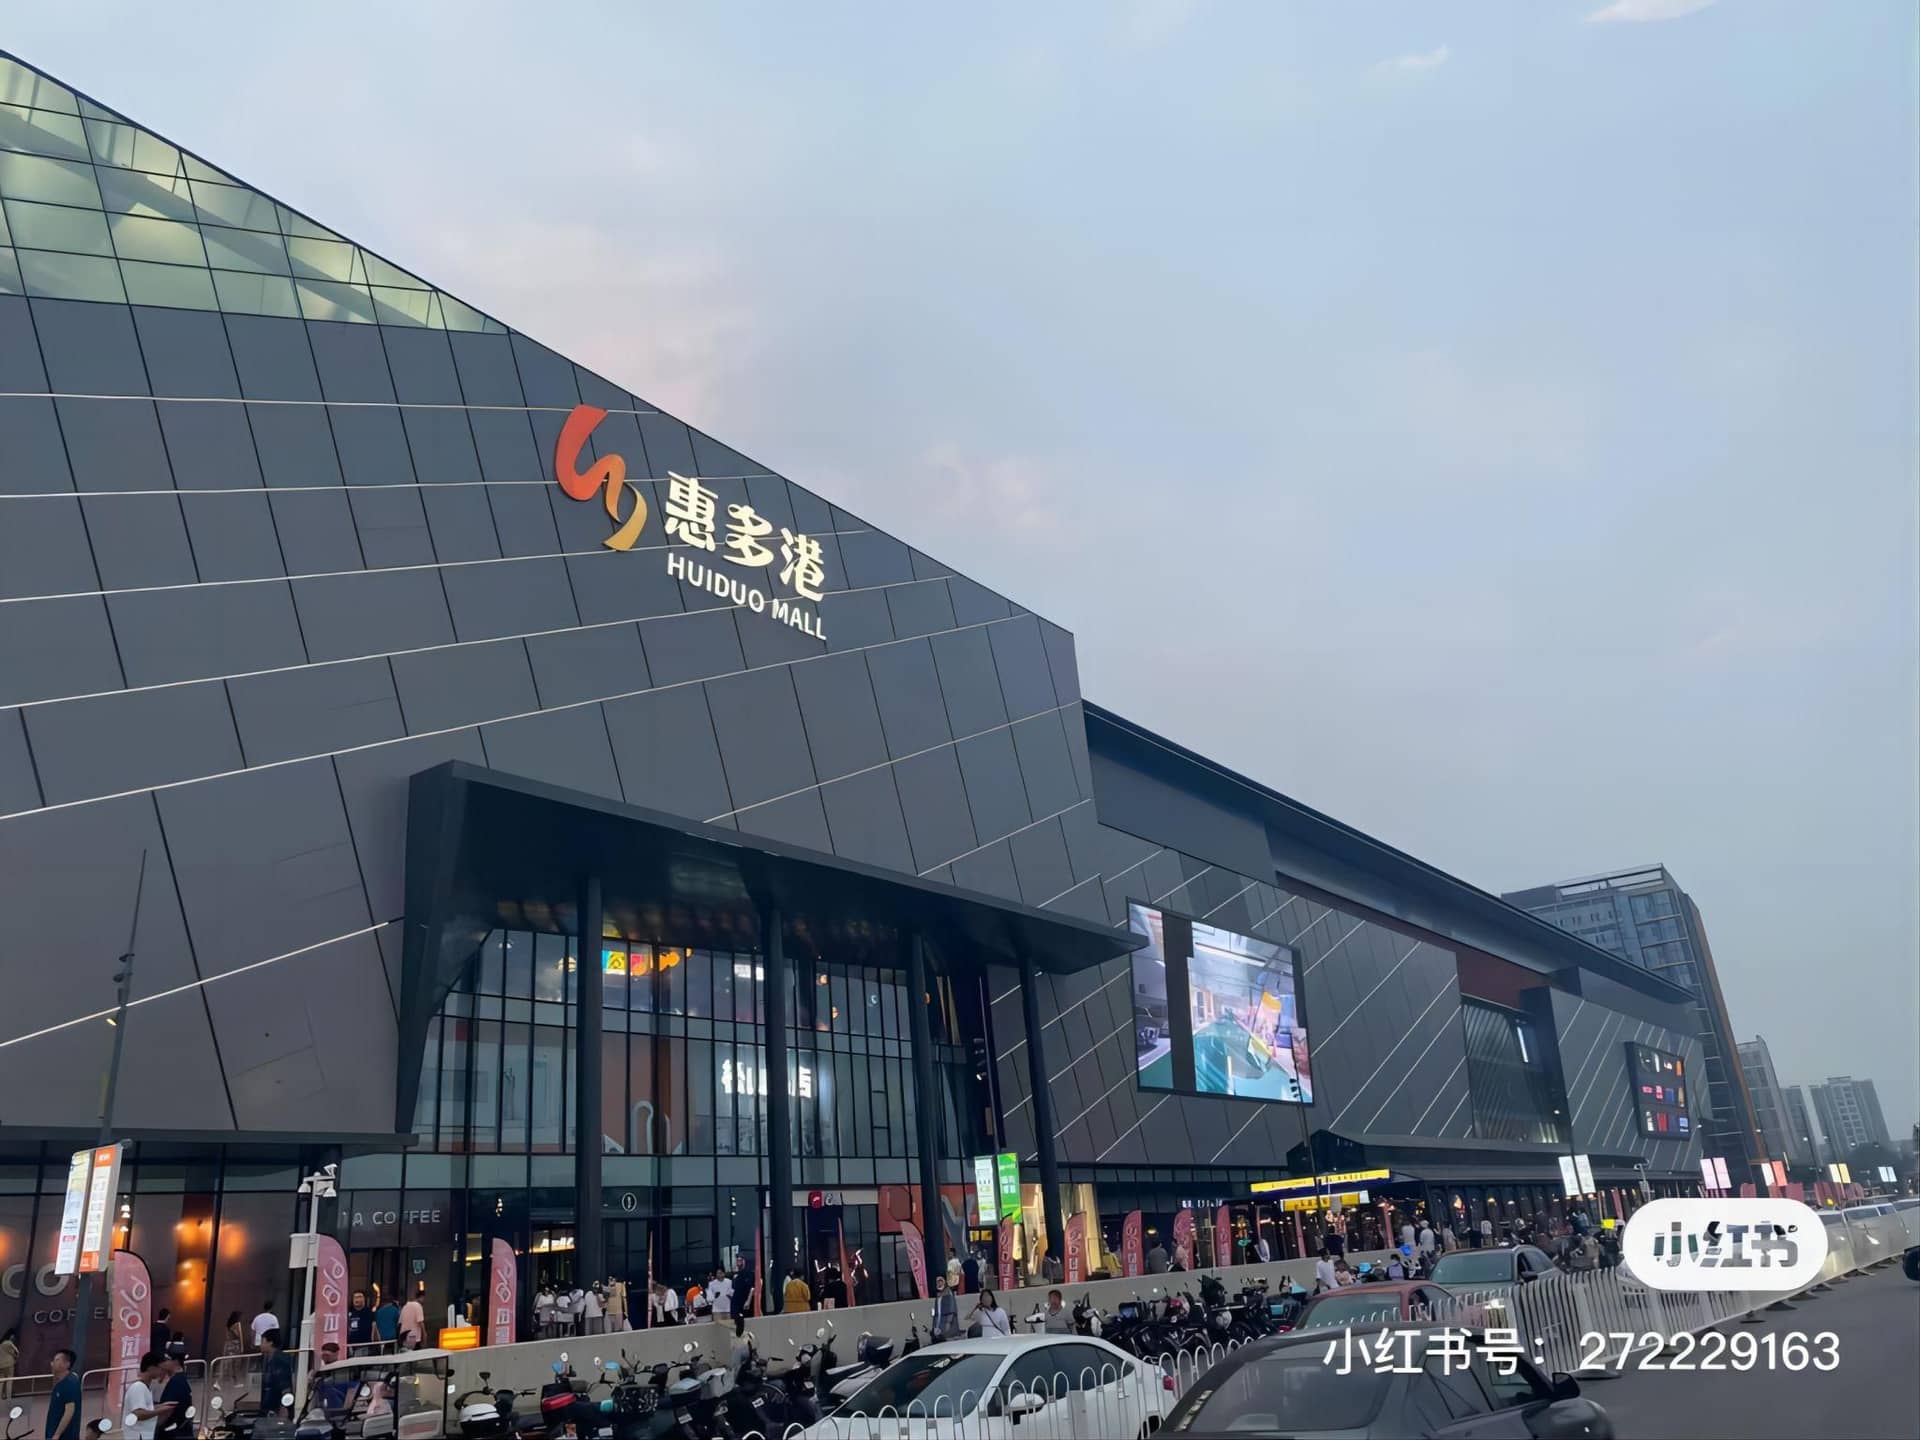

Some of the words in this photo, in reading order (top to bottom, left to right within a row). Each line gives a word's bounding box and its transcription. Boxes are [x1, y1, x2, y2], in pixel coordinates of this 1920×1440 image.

[665, 471, 825, 601] 惠多港
[667, 552, 765, 613] HUIDUO
[772, 598, 827, 641] MALL
